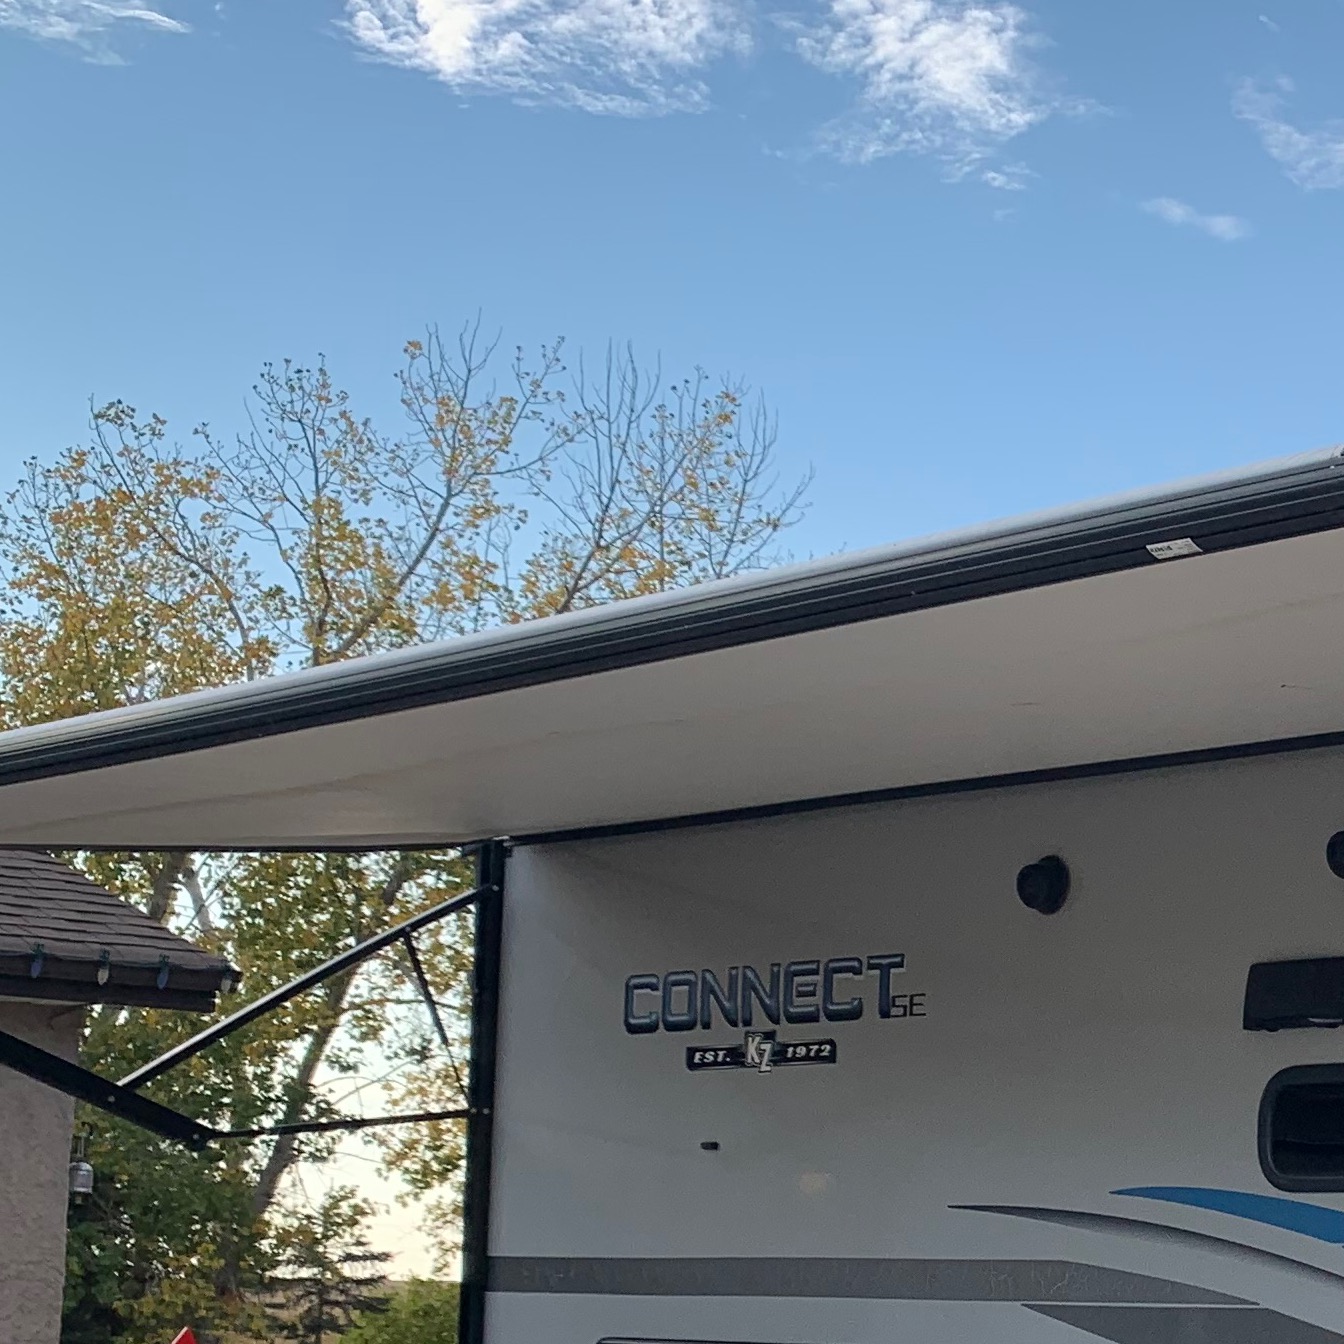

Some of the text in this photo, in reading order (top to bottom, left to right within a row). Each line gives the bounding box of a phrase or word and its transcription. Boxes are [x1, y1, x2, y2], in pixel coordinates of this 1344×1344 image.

[623, 953, 927, 1035] CONNECT SE
[693, 1032, 832, 1074] EST. KZ 1972
